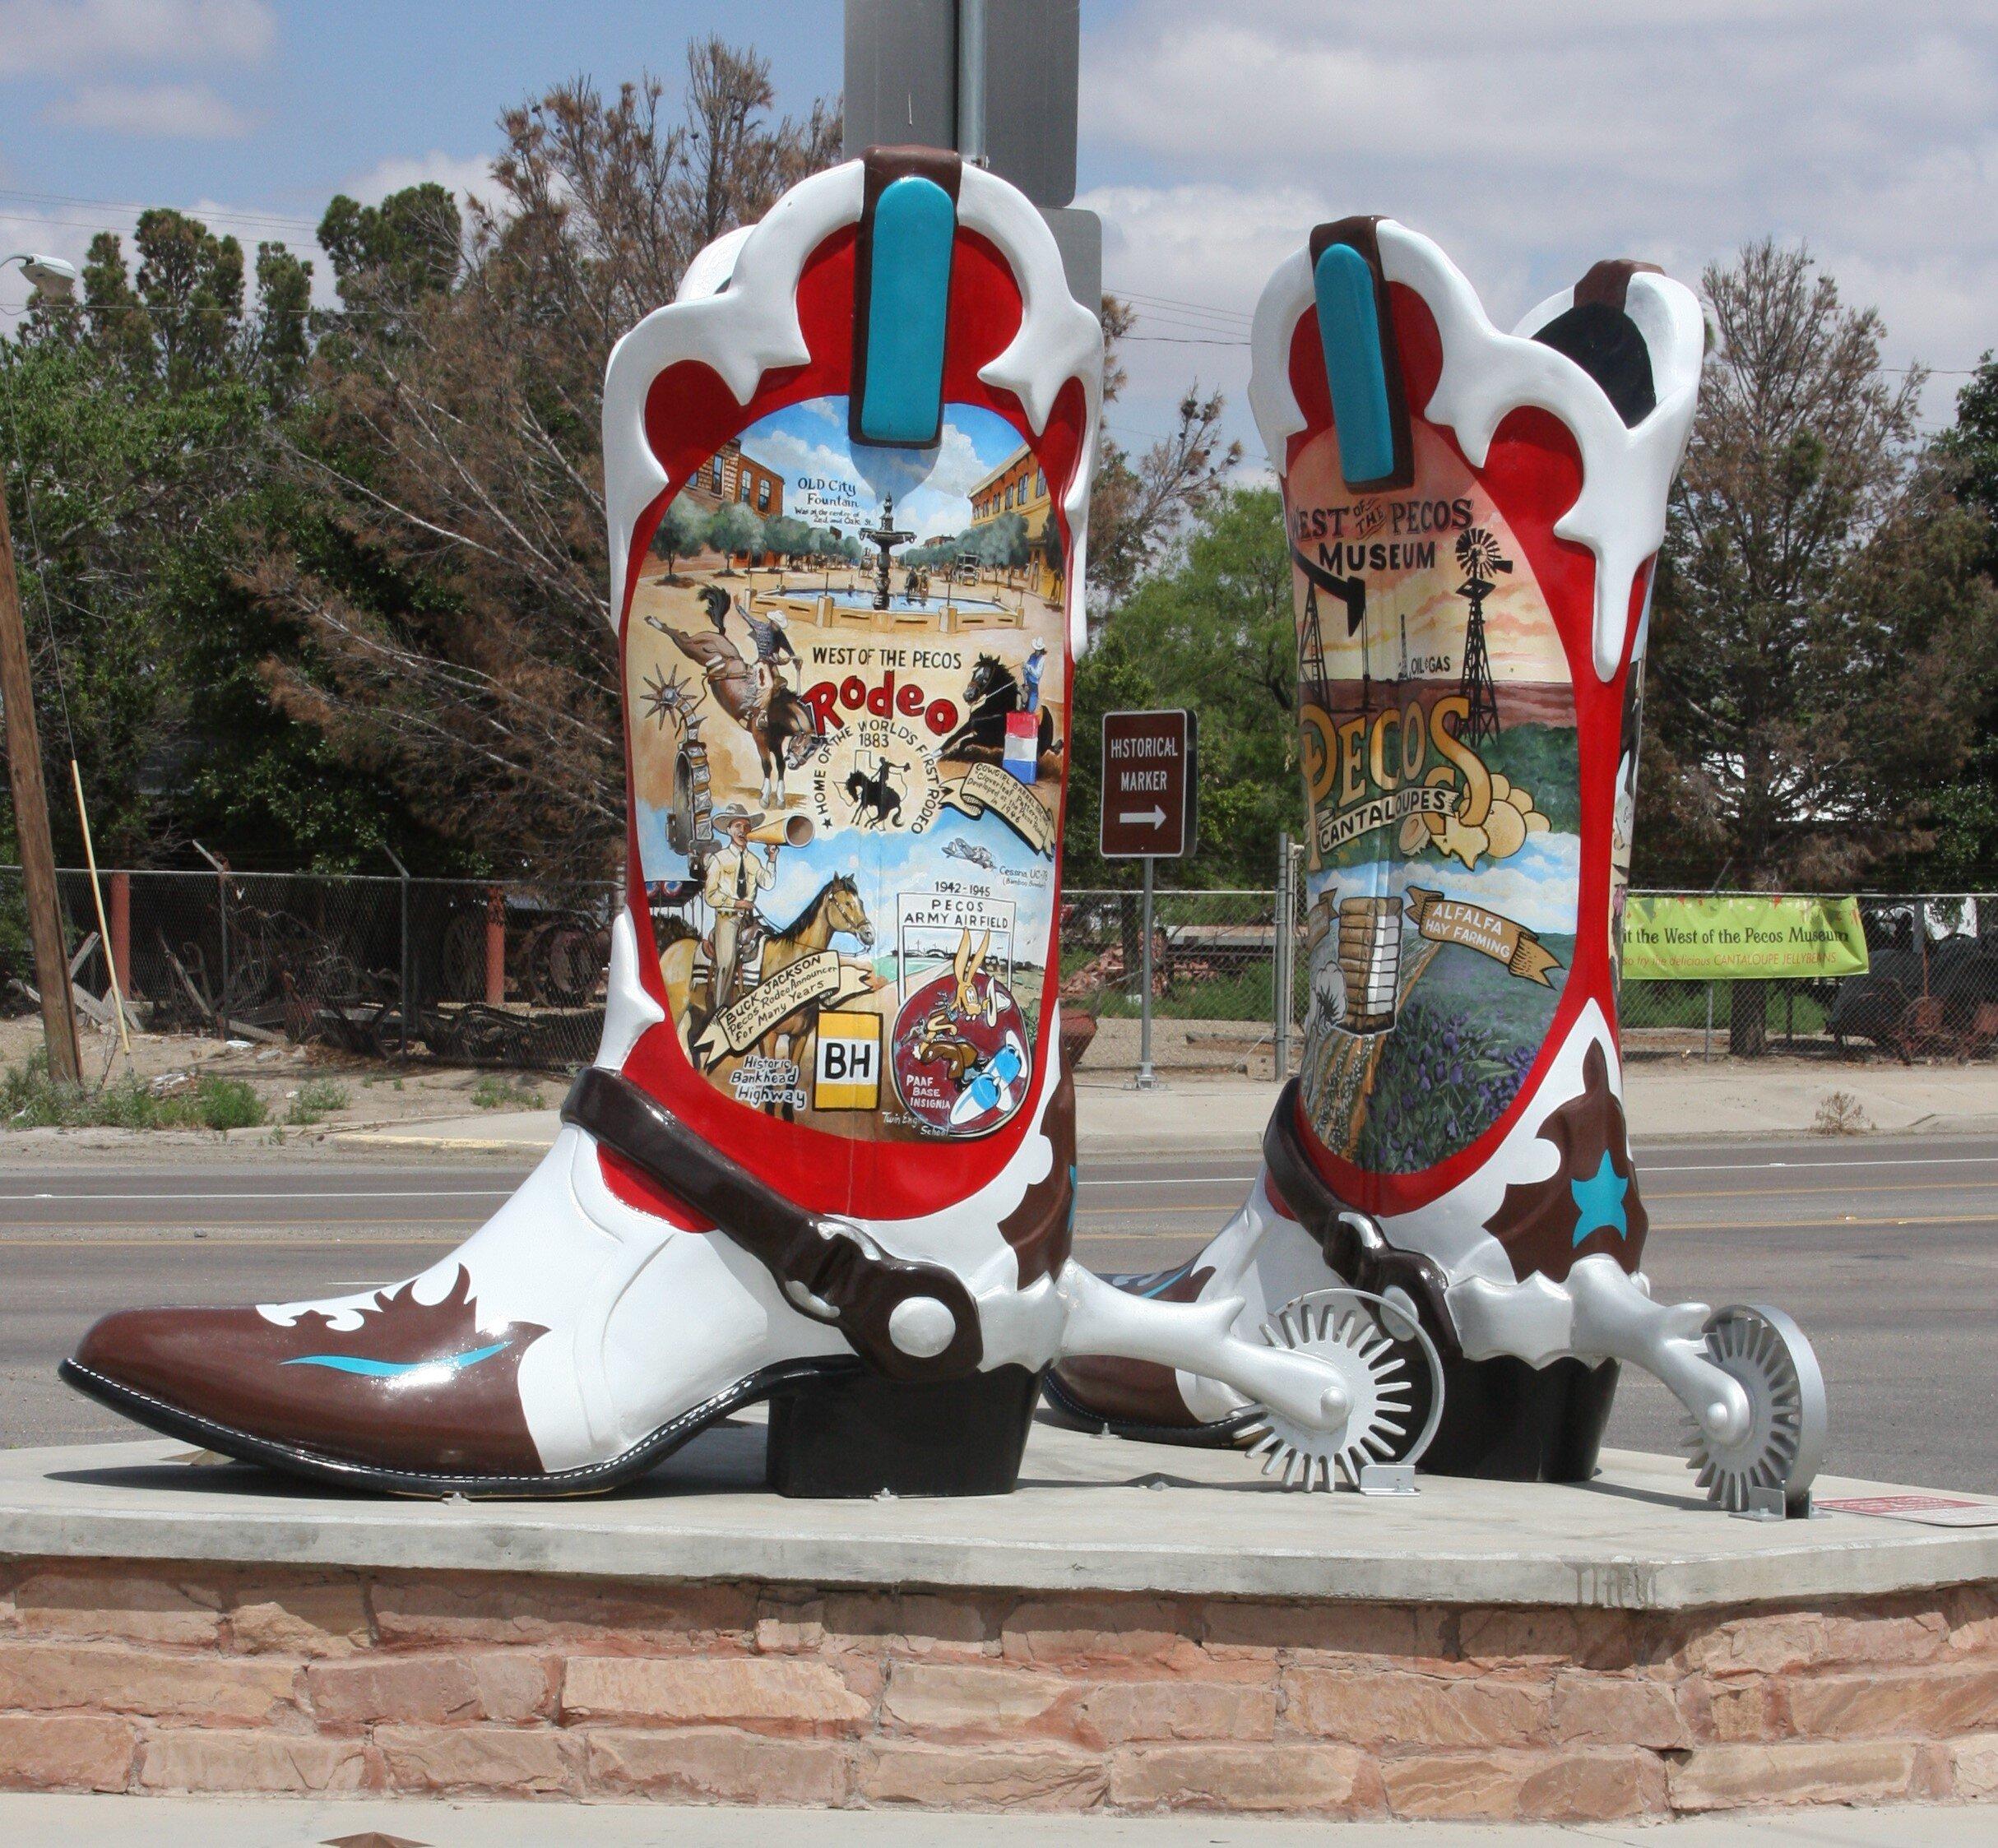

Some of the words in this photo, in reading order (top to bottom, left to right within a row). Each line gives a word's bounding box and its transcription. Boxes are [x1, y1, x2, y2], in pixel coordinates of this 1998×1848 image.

[798, 477, 825, 489] OLD
[828, 479, 856, 497] City
[807, 493, 859, 507] Fountain
[1356, 505, 1384, 535] THE
[1389, 498, 1475, 535] PECOS
[1319, 541, 1435, 576] MUSEUM
[813, 646, 856, 665] WEST
[858, 648, 875, 665] OF
[879, 649, 906, 667] THE
[913, 651, 962, 669] PECOS
[798, 669, 959, 736] Rodeo
[827, 726, 854, 746] THE
[858, 720, 919, 745] WORLD'S
[859, 733, 889, 748] 1883
[818, 743, 832, 764] OF
[1110, 737, 1178, 759] HISTORICAL
[915, 744, 939, 785] FIRST
[976, 763, 1010, 785] COWGIRL
[814, 770, 828, 815] HOME
[1120, 771, 1167, 792] MARKER
[1300, 695, 1492, 871] PECOS
[911, 788, 939, 834] RODEO
[1320, 790, 1446, 850] CANTALOUPES
[931, 899, 984, 912] PECOS
[904, 913, 949, 924] ARMY
[1432, 904, 1503, 935] ALFALFA
[1425, 919, 1450, 935] HAY
[1453, 926, 1510, 958] FARMING
[1636, 928, 1659, 943] the
[1664, 927, 1698, 944] West
[1703, 929, 1714, 943] of
[1718, 929, 1741, 943] the
[1745, 927, 1783, 943] Pecos
[1788, 926, 1849, 943] Museum
[1637, 956, 1648, 968] try
[1653, 955, 1667, 966] the
[1669, 955, 1711, 966] delicious
[1713, 953, 1779, 966] CANTALOUPE
[725, 993, 763, 1026] BUCK
[764, 954, 821, 994] JACKSON
[728, 1007, 759, 1036] Pecos
[762, 986, 790, 1009] Rodeo
[790, 966, 838, 989] Announcer
[735, 1026, 753, 1044] for
[758, 1003, 787, 1026] Many
[789, 980, 824, 1003] Years
[744, 1056, 792, 1069] Historic
[824, 1042, 871, 1079] BH
[730, 1068, 796, 1083] Bankhead
[906, 1074, 934, 1087] PAAF
[738, 1086, 805, 1109] Highway
[912, 1087, 941, 1096] BASE
[910, 1097, 951, 1109] INSIGNIA
[882, 1111, 901, 1124] Twin
[920, 1125, 949, 1136] School
